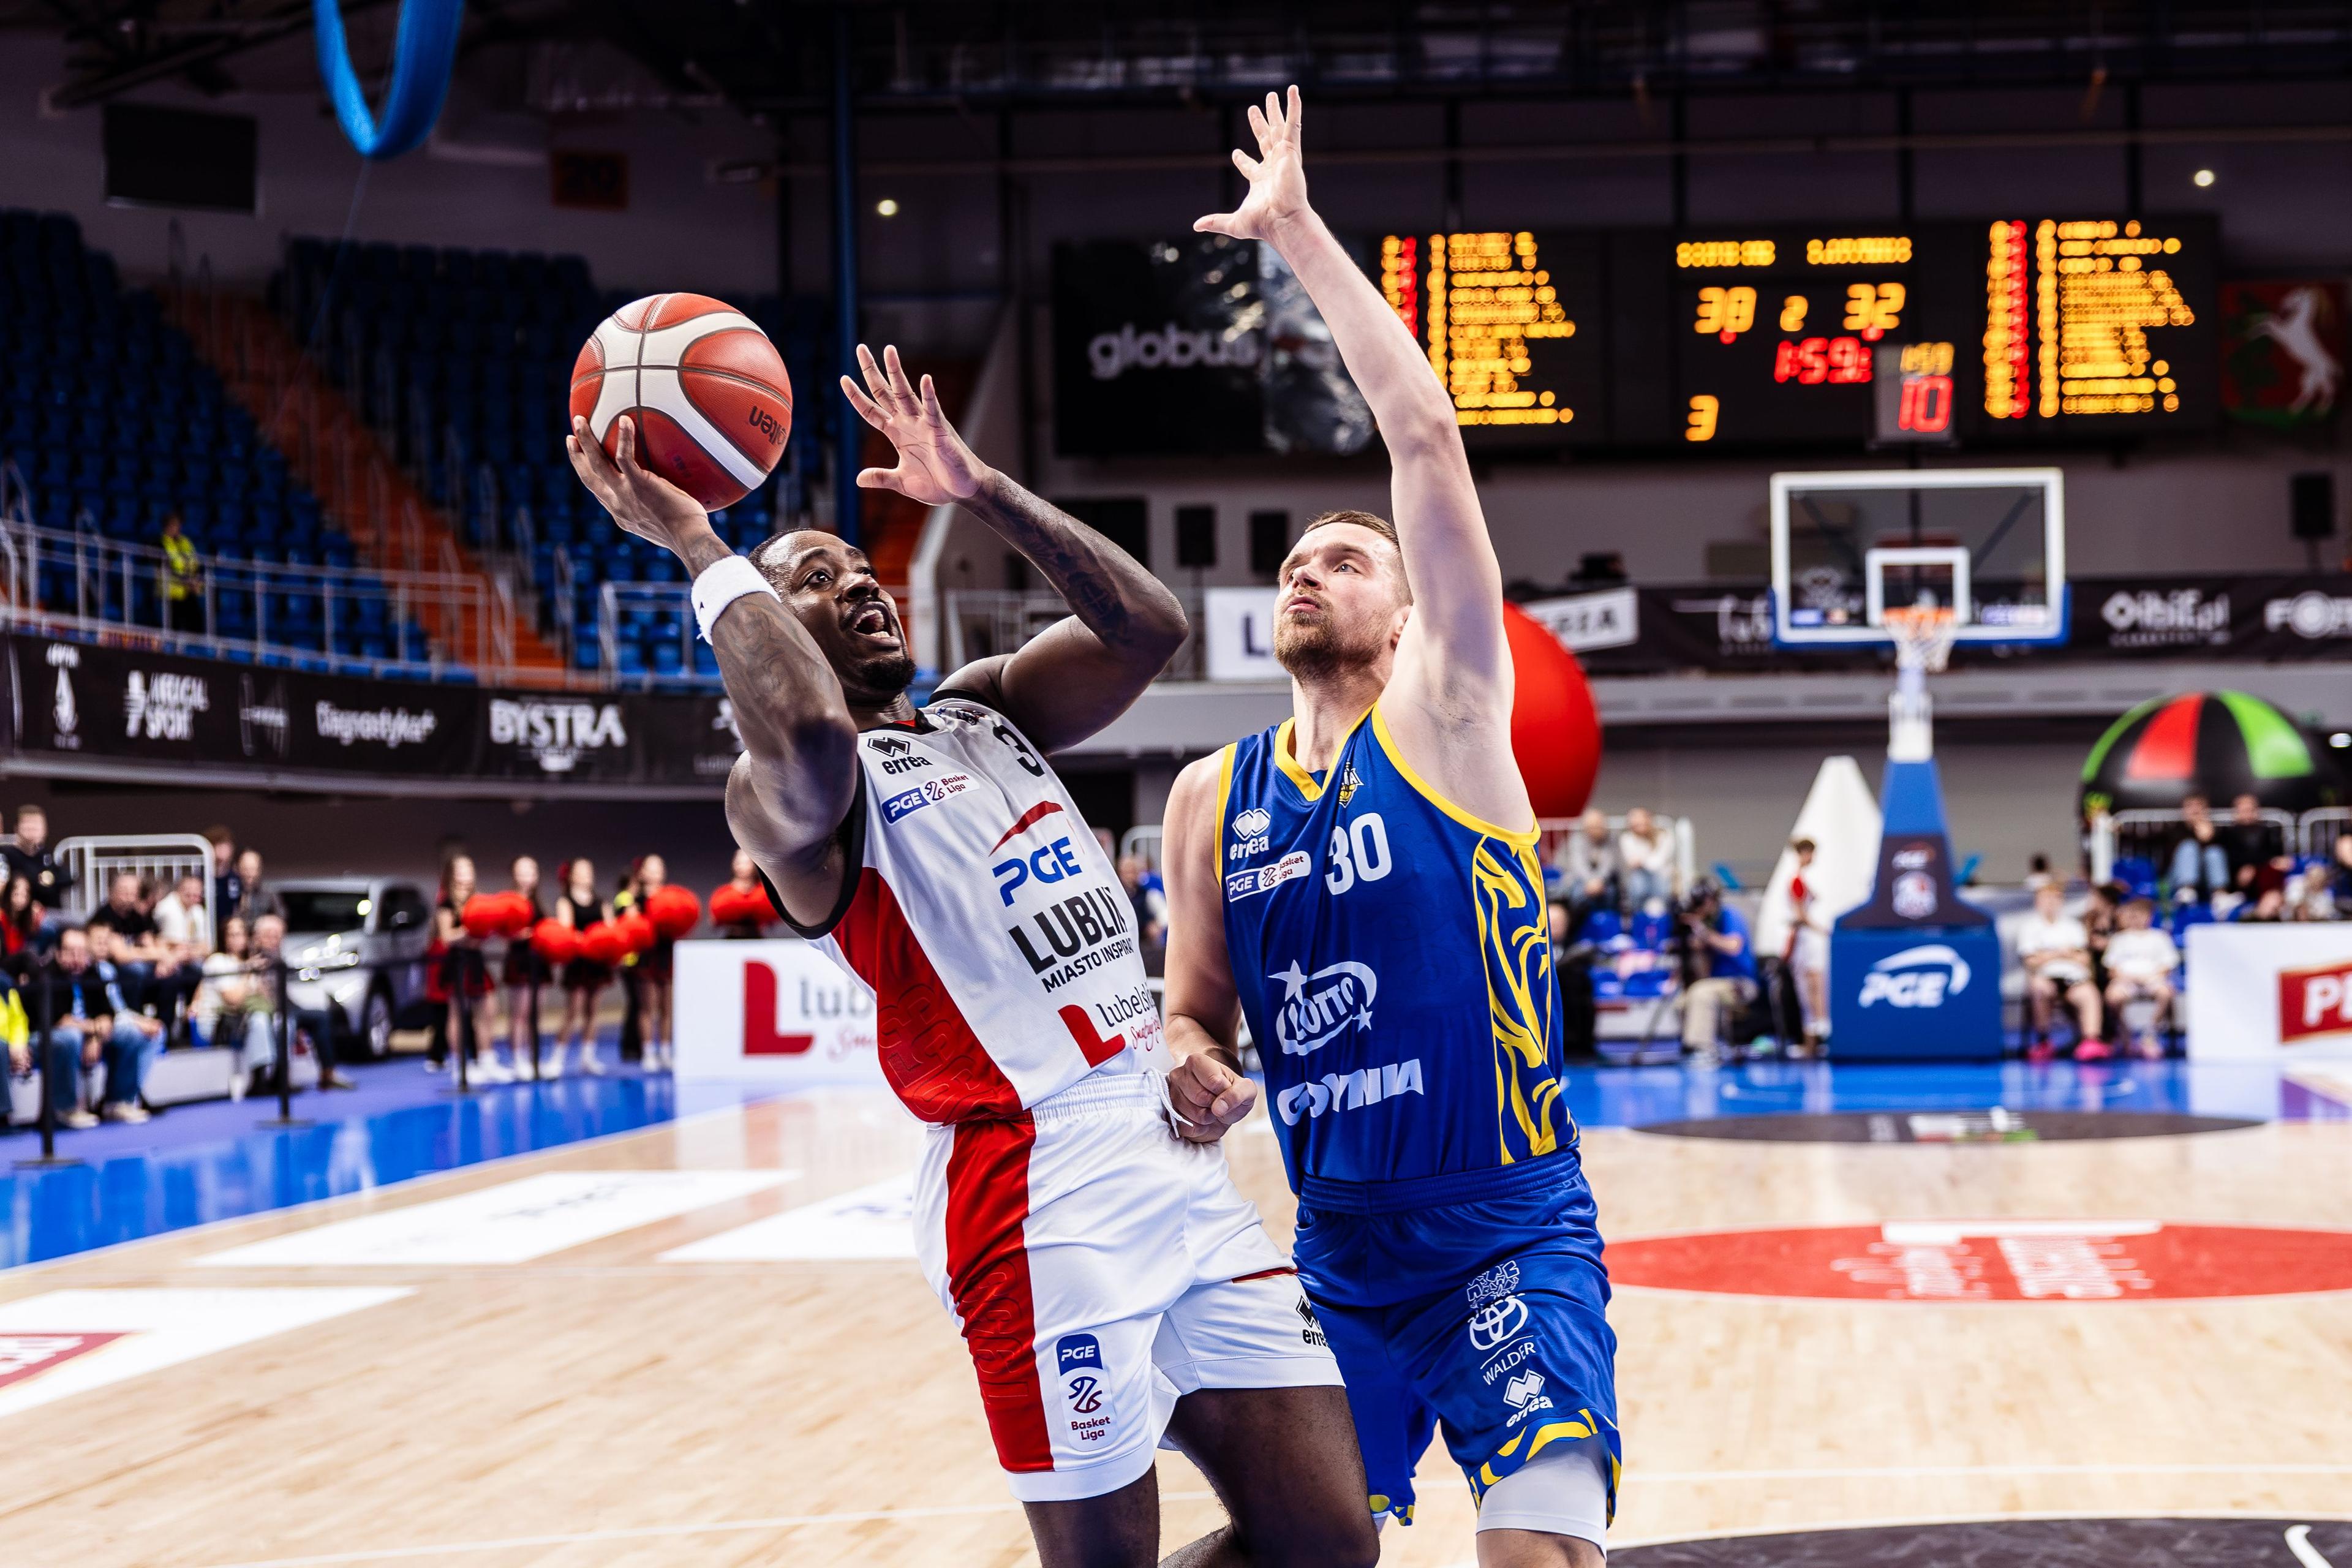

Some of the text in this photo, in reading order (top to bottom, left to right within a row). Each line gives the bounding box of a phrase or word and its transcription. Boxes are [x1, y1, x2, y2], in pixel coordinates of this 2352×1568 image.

[1843, 283, 1905, 330] 32
[1686, 395, 1719, 441] 3
[1899, 375, 1953, 432] 10
[490, 699, 627, 747] BYSTRA
[940, 774, 969, 786] Basket
[946, 783, 966, 794] Liga
[889, 791, 923, 818] PGE
[992, 836, 1083, 908] PGE
[1325, 813, 1392, 895] 30
[1229, 875, 1254, 895] PGE
[1041, 951, 1102, 993] MIASTO
[1858, 971, 1949, 1008] PGE
[1288, 977, 1354, 1041] LOTTO
[1277, 1058, 1424, 1126] GDYNIA
[1061, 1344, 1096, 1362] PGE
[1303, 1329, 1329, 1348] erre
[1483, 1341, 1537, 1385] WALDER
[1071, 1416, 1111, 1431] Basket
[1080, 1429, 1106, 1441] Liga
